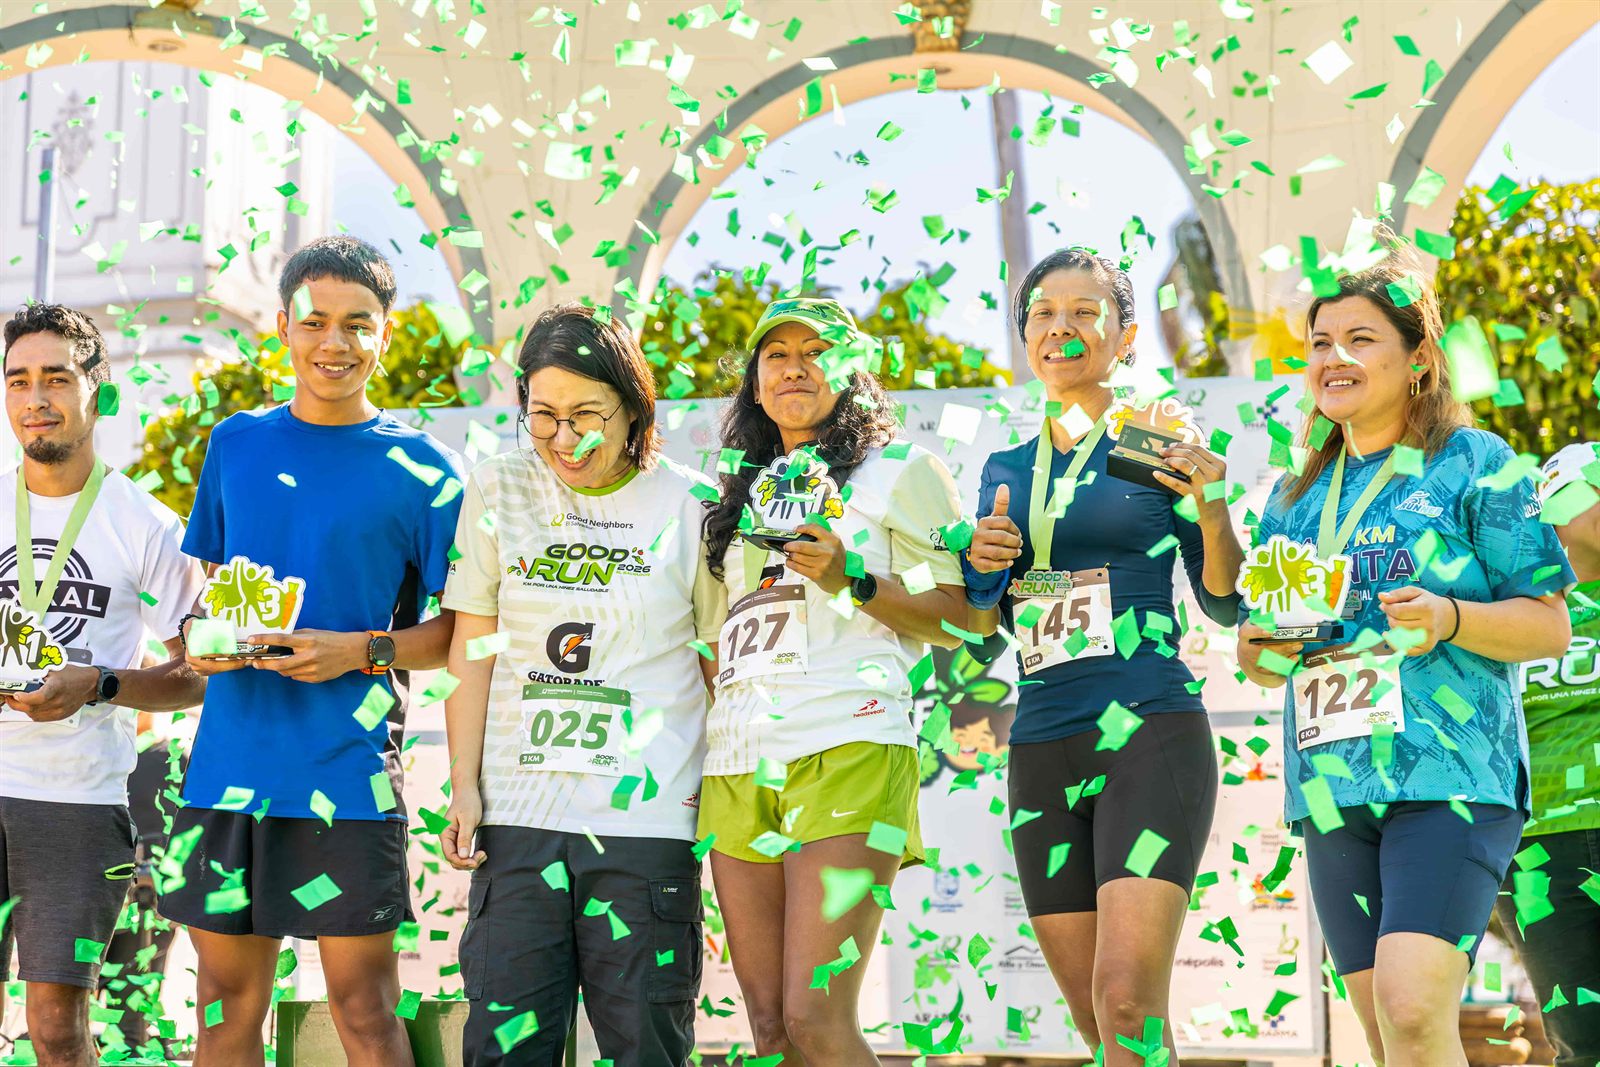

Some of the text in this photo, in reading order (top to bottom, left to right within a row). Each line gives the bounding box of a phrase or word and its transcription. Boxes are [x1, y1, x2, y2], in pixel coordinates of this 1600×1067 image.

[566, 513, 634, 530] Good Neighbors
[1353, 525, 1396, 548] KM
[545, 543, 630, 563] GOOD
[526, 558, 652, 587] RUN 2026
[1026, 573, 1062, 581] GOOD
[1020, 582, 1056, 594] RUN
[1306, 567, 1326, 600] 3
[262, 587, 281, 622] 3
[1032, 596, 1091, 648] 145
[26, 631, 41, 663] 1
[727, 611, 791, 663] 127
[527, 671, 601, 687] GATORADE
[1303, 668, 1378, 720] 122
[1531, 693, 1549, 702] POR
[1550, 691, 1569, 699] UNA
[530, 709, 613, 751] 025
[1305, 729, 1317, 738] KM
[591, 759, 611, 767] RUN
[595, 753, 615, 761] GOOD
